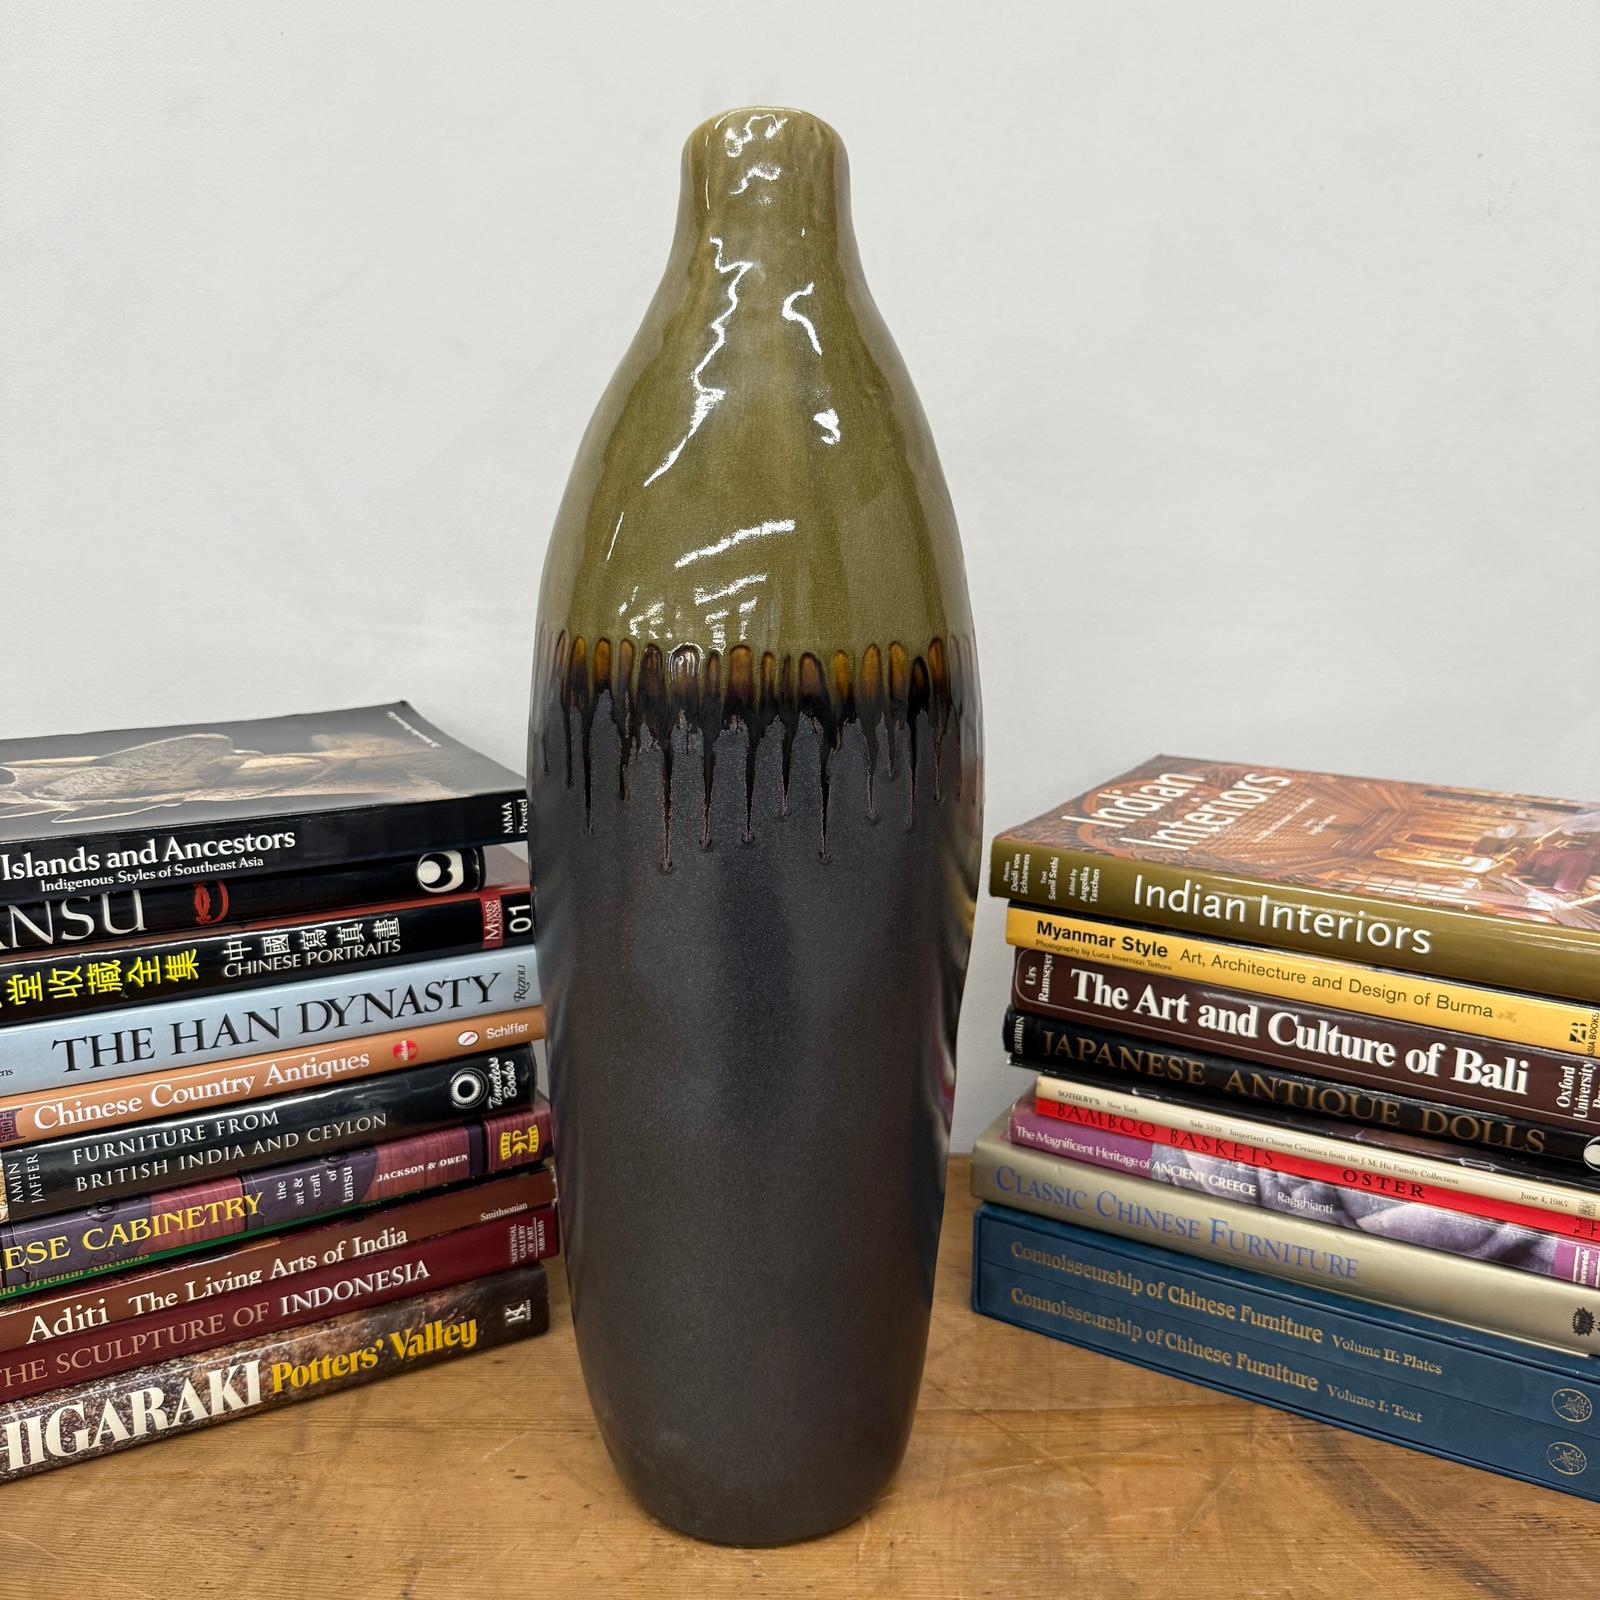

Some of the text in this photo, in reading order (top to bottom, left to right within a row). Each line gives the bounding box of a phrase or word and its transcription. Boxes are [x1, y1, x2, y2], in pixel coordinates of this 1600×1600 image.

[502, 801, 513, 834] MMA
[516, 798, 528, 834] Prestel
[1062, 772, 1206, 829] Indian
[1119, 773, 1291, 851] Interiors
[1, 831, 296, 881] Islands and Ancestors
[41, 856, 264, 892] Indigenous Styles of Southeast Asia
[1011, 853, 1021, 892] Deidi von
[1020, 853, 1030, 894] Schaewen
[1049, 856, 1059, 900] Sunil Sethi
[1068, 877, 1077, 896] Edited
[1079, 866, 1090, 902] Angelika
[1089, 868, 1100, 903] Taschen
[0, 889, 148, 950] NSU
[508, 903, 533, 934] 01
[1134, 874, 1432, 955] Indian Interiors
[224, 939, 401, 978] CHINESE PORTRAITS
[1035, 939, 1080, 954] Photography
[1081, 948, 1090, 957] by
[1092, 950, 1110, 960] Luca
[1037, 920, 1493, 1019] Myanmar Style Art, Architecture and Design of Burma
[0, 948, 200, 1008] 堂收藏全集
[1025, 966, 1036, 985] Urs
[1038, 952, 1053, 1002] Ramseyer
[51, 972, 502, 1073] THE HAN DYNASTY
[486, 1022, 529, 1039] Schiffer
[1016, 1015, 1025, 1055] GRIBBIN
[1070, 968, 1529, 1096] The Art and Culture of Bali
[1588, 1012, 1600, 1040] BOOKS
[34, 1053, 370, 1130] Chinese Country Antiques
[488, 1056, 502, 1110] Timeless
[503, 1060, 518, 1098] Books
[1043, 1030, 1546, 1154] JAPANESE ANTIQUE DOLLS
[1556, 1066, 1575, 1108] Oxford
[1574, 1060, 1595, 1120] University
[72, 1110, 280, 1166] FURNITURE FROM
[76, 1112, 388, 1193] BRITISH INDIA AND CEYLON
[1056, 1103, 1156, 1138] BAMBOO
[1169, 1128, 1274, 1166] BASKETS
[1343, 1170, 1425, 1199] OSTER
[1057, 1089, 1100, 1105] SOTHEBY'S
[1107, 1101, 1121, 1110] New
[1122, 1104, 1138, 1114] York
[1229, 1129, 1265, 1143] Important
[1265, 1136, 1293, 1149] Chinese
[1294, 1142, 1328, 1157] Ceramics
[1328, 1150, 1346, 1161] from
[1347, 1153, 1359, 1163] the
[1392, 1163, 1419, 1178] Family
[1420, 1169, 1459, 1185] Collection
[1519, 1190, 1538, 1202] June
[25, 1152, 46, 1204] JAFFER
[326, 1169, 337, 1181] of
[376, 1153, 468, 1182] JACKSON & OWEN
[1016, 1125, 1035, 1141] The
[1035, 1131, 1094, 1157] Magnificent
[1096, 1145, 1139, 1169] Heritage
[1139, 1157, 1151, 1170] of
[1152, 1161, 1207, 1185] ANCIENT
[1208, 1172, 1257, 1196] GREECE
[8, 1162, 25, 1204] AMIN
[277, 1180, 287, 1200] the
[294, 1178, 305, 1205] art &
[310, 1172, 321, 1198] craft
[342, 1166, 354, 1203] tansu
[1277, 1191, 1335, 1215] Ragghianti
[0, 1192, 263, 1273] ESE CABINETRY
[480, 1202, 528, 1221] Smithsonian
[996, 1164, 1360, 1280] CLASSIC CHINESE FURNITURE
[510, 1223, 519, 1264] NATIONAL
[518, 1224, 527, 1259] GALLERY
[526, 1226, 534, 1240] ART
[537, 1220, 546, 1252] ABRAMS
[26, 1227, 408, 1345] Aditi The Living Arts of India
[56, 1313, 226, 1374] SCULPTURE
[233, 1302, 270, 1328] OF
[280, 1260, 431, 1316] INDONESIA
[1011, 1240, 1443, 1375] Connoisseurship of Chinese Furniture Volume II: Plates
[390, 1318, 478, 1361] Valley
[1011, 1287, 1423, 1423] Connoisseurship of Chinese Furniture Volume I: Text
